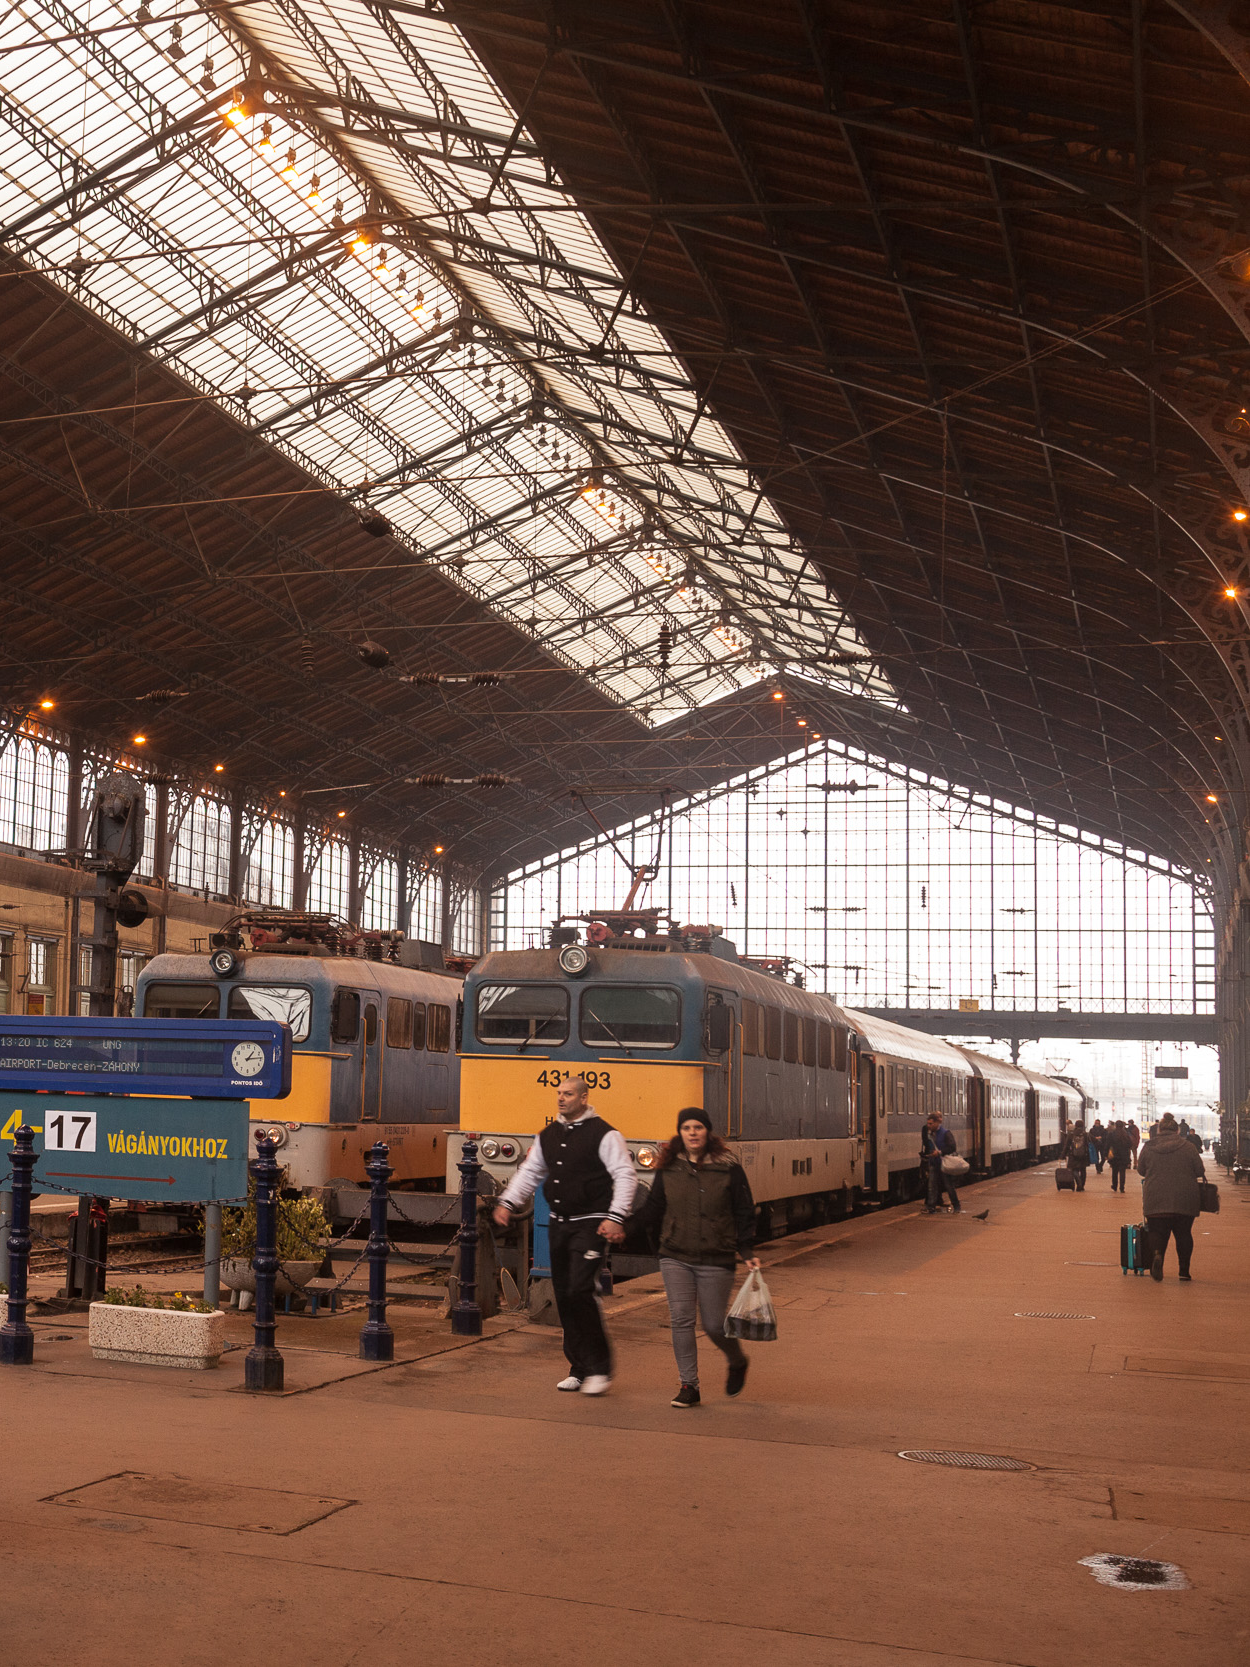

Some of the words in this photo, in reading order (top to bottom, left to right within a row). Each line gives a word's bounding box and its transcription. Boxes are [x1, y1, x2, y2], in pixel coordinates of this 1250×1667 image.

[1, 1038, 31, 1047] 13:20
[36, 1037, 49, 1048] IC
[53, 1038, 72, 1048] 624
[102, 1040, 122, 1050] UNG
[0, 1059, 140, 1073] AIRPORT-Debrecen-ZÁHONY
[50, 1115, 92, 1149] 17
[107, 1130, 228, 1159] VÁGÁNYOKHOZ
